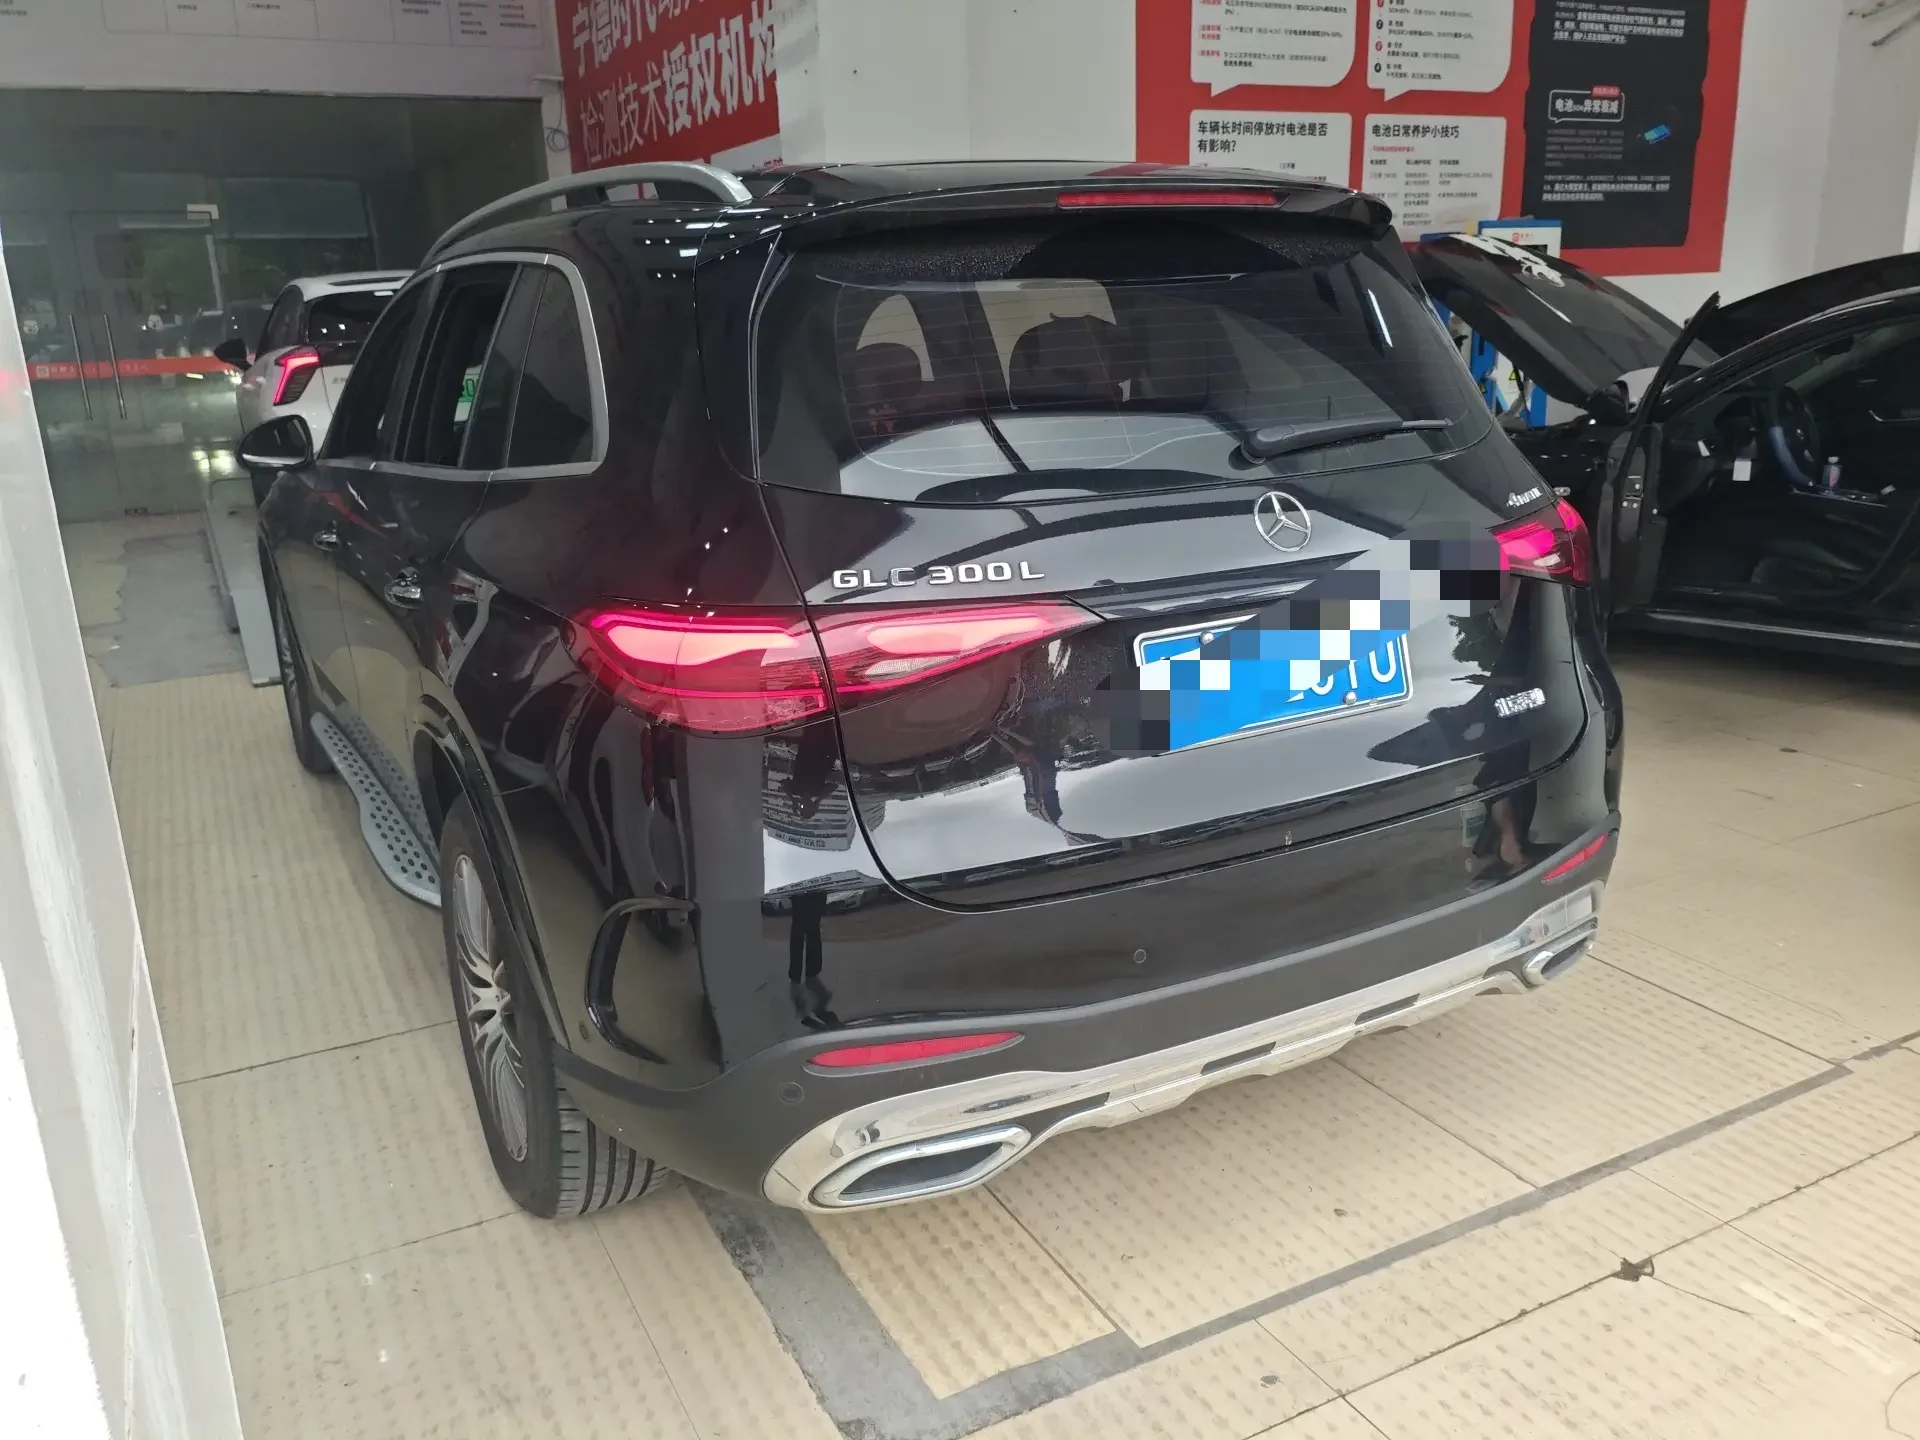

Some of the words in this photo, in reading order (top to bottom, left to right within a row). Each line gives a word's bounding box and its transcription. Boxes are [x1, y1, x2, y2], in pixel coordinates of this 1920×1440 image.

[580, 0, 778, 168] 检测技术授权机构
[1198, 120, 1328, 136] 车辆长时间停放对电池是否
[1372, 124, 1460, 138] 电池日常养护小技巧
[832, 567, 917, 589] GLC
[928, 562, 1012, 585] 300
[1019, 561, 1046, 580] L
